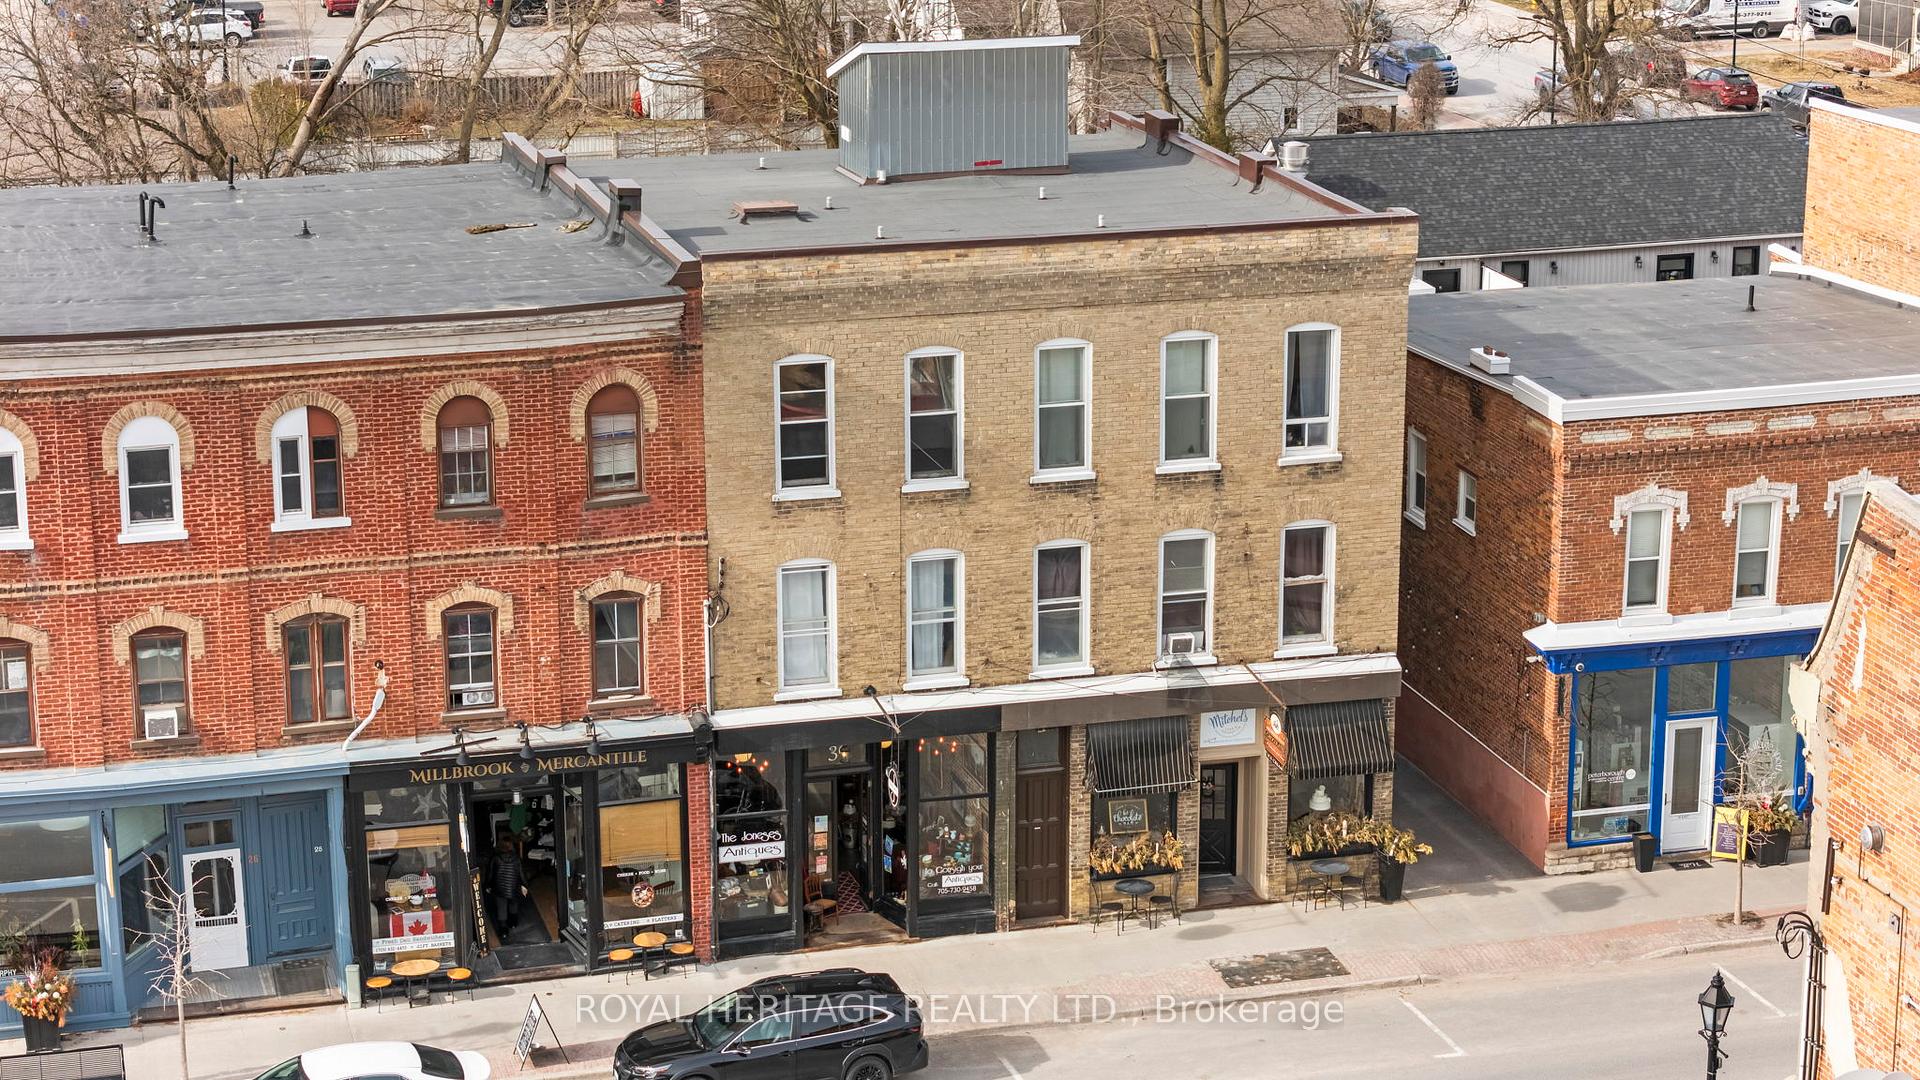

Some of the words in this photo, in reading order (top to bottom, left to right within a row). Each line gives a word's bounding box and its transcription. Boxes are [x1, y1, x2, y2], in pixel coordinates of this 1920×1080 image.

[409, 761, 514, 784] MILLBROOK
[536, 750, 648, 772] MERCANTILE
[721, 833, 737, 843] The
[741, 830, 782, 842] Joneses
[723, 845, 782, 858] Antiques
[473, 882, 487, 944] WELCOME
